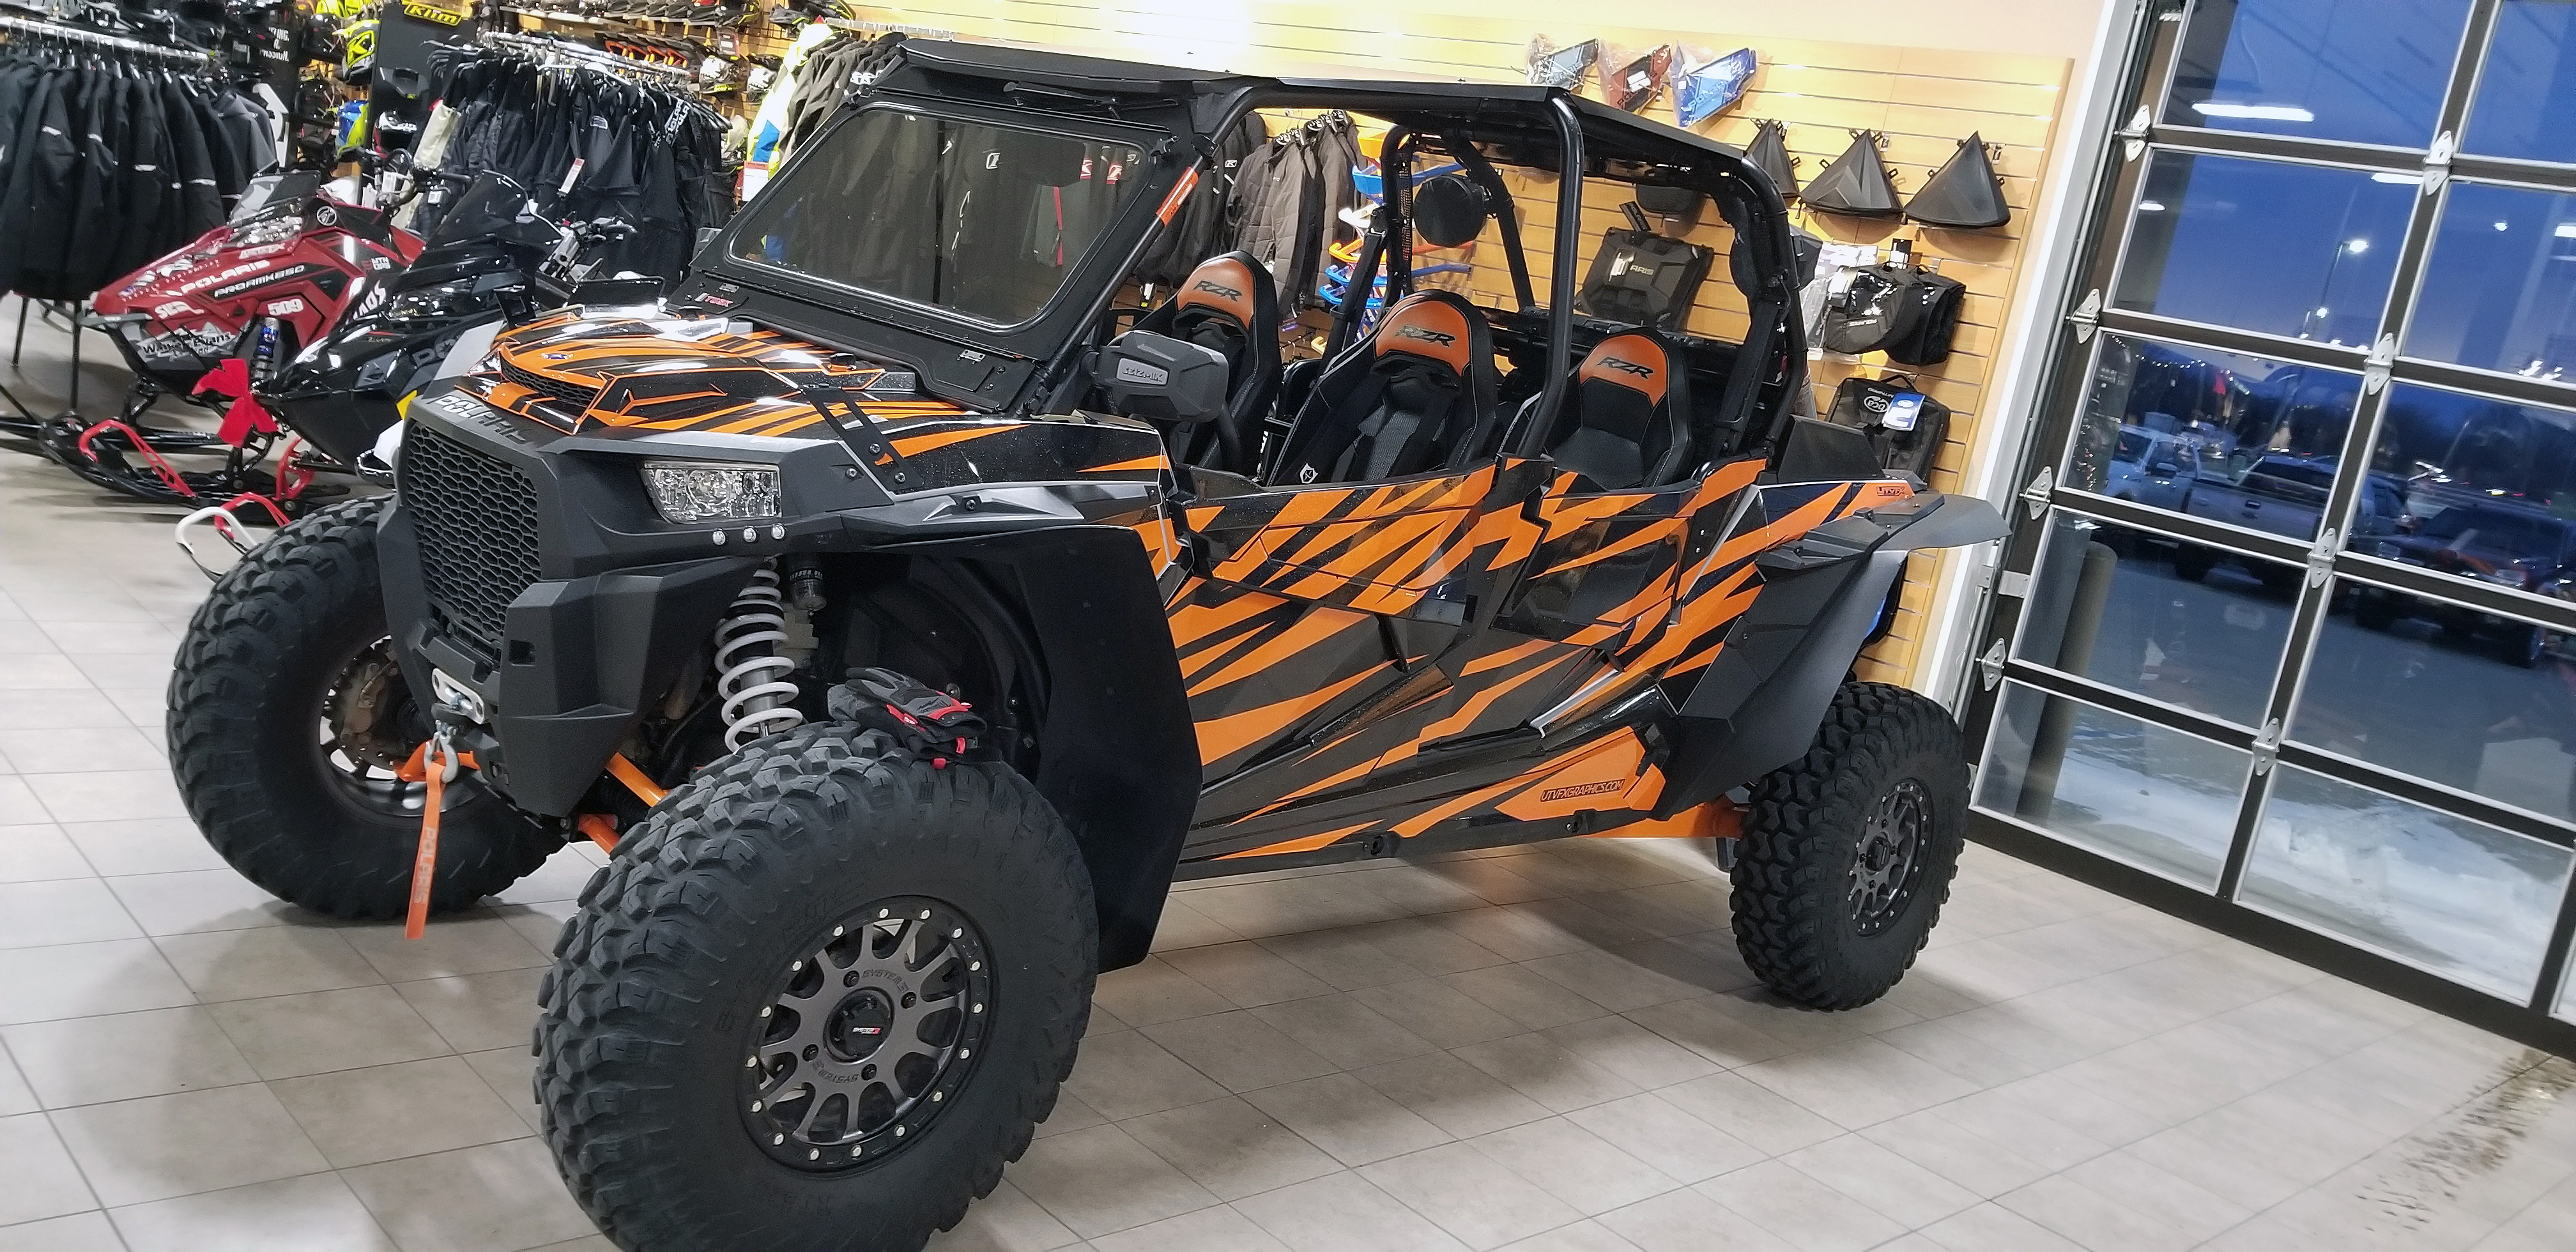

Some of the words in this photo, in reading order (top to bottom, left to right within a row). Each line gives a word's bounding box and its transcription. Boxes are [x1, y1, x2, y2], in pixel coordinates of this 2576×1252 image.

[180, 259, 270, 294] POLARIS
[1192, 280, 1243, 302] RZR
[267, 298, 304, 316] 509
[1394, 324, 1456, 347] RZR
[1122, 366, 1165, 383] SEIZMIK
[1597, 356, 1655, 379] RZR
[426, 393, 534, 446] POLARIS
[414, 827, 436, 904] POLARIS
